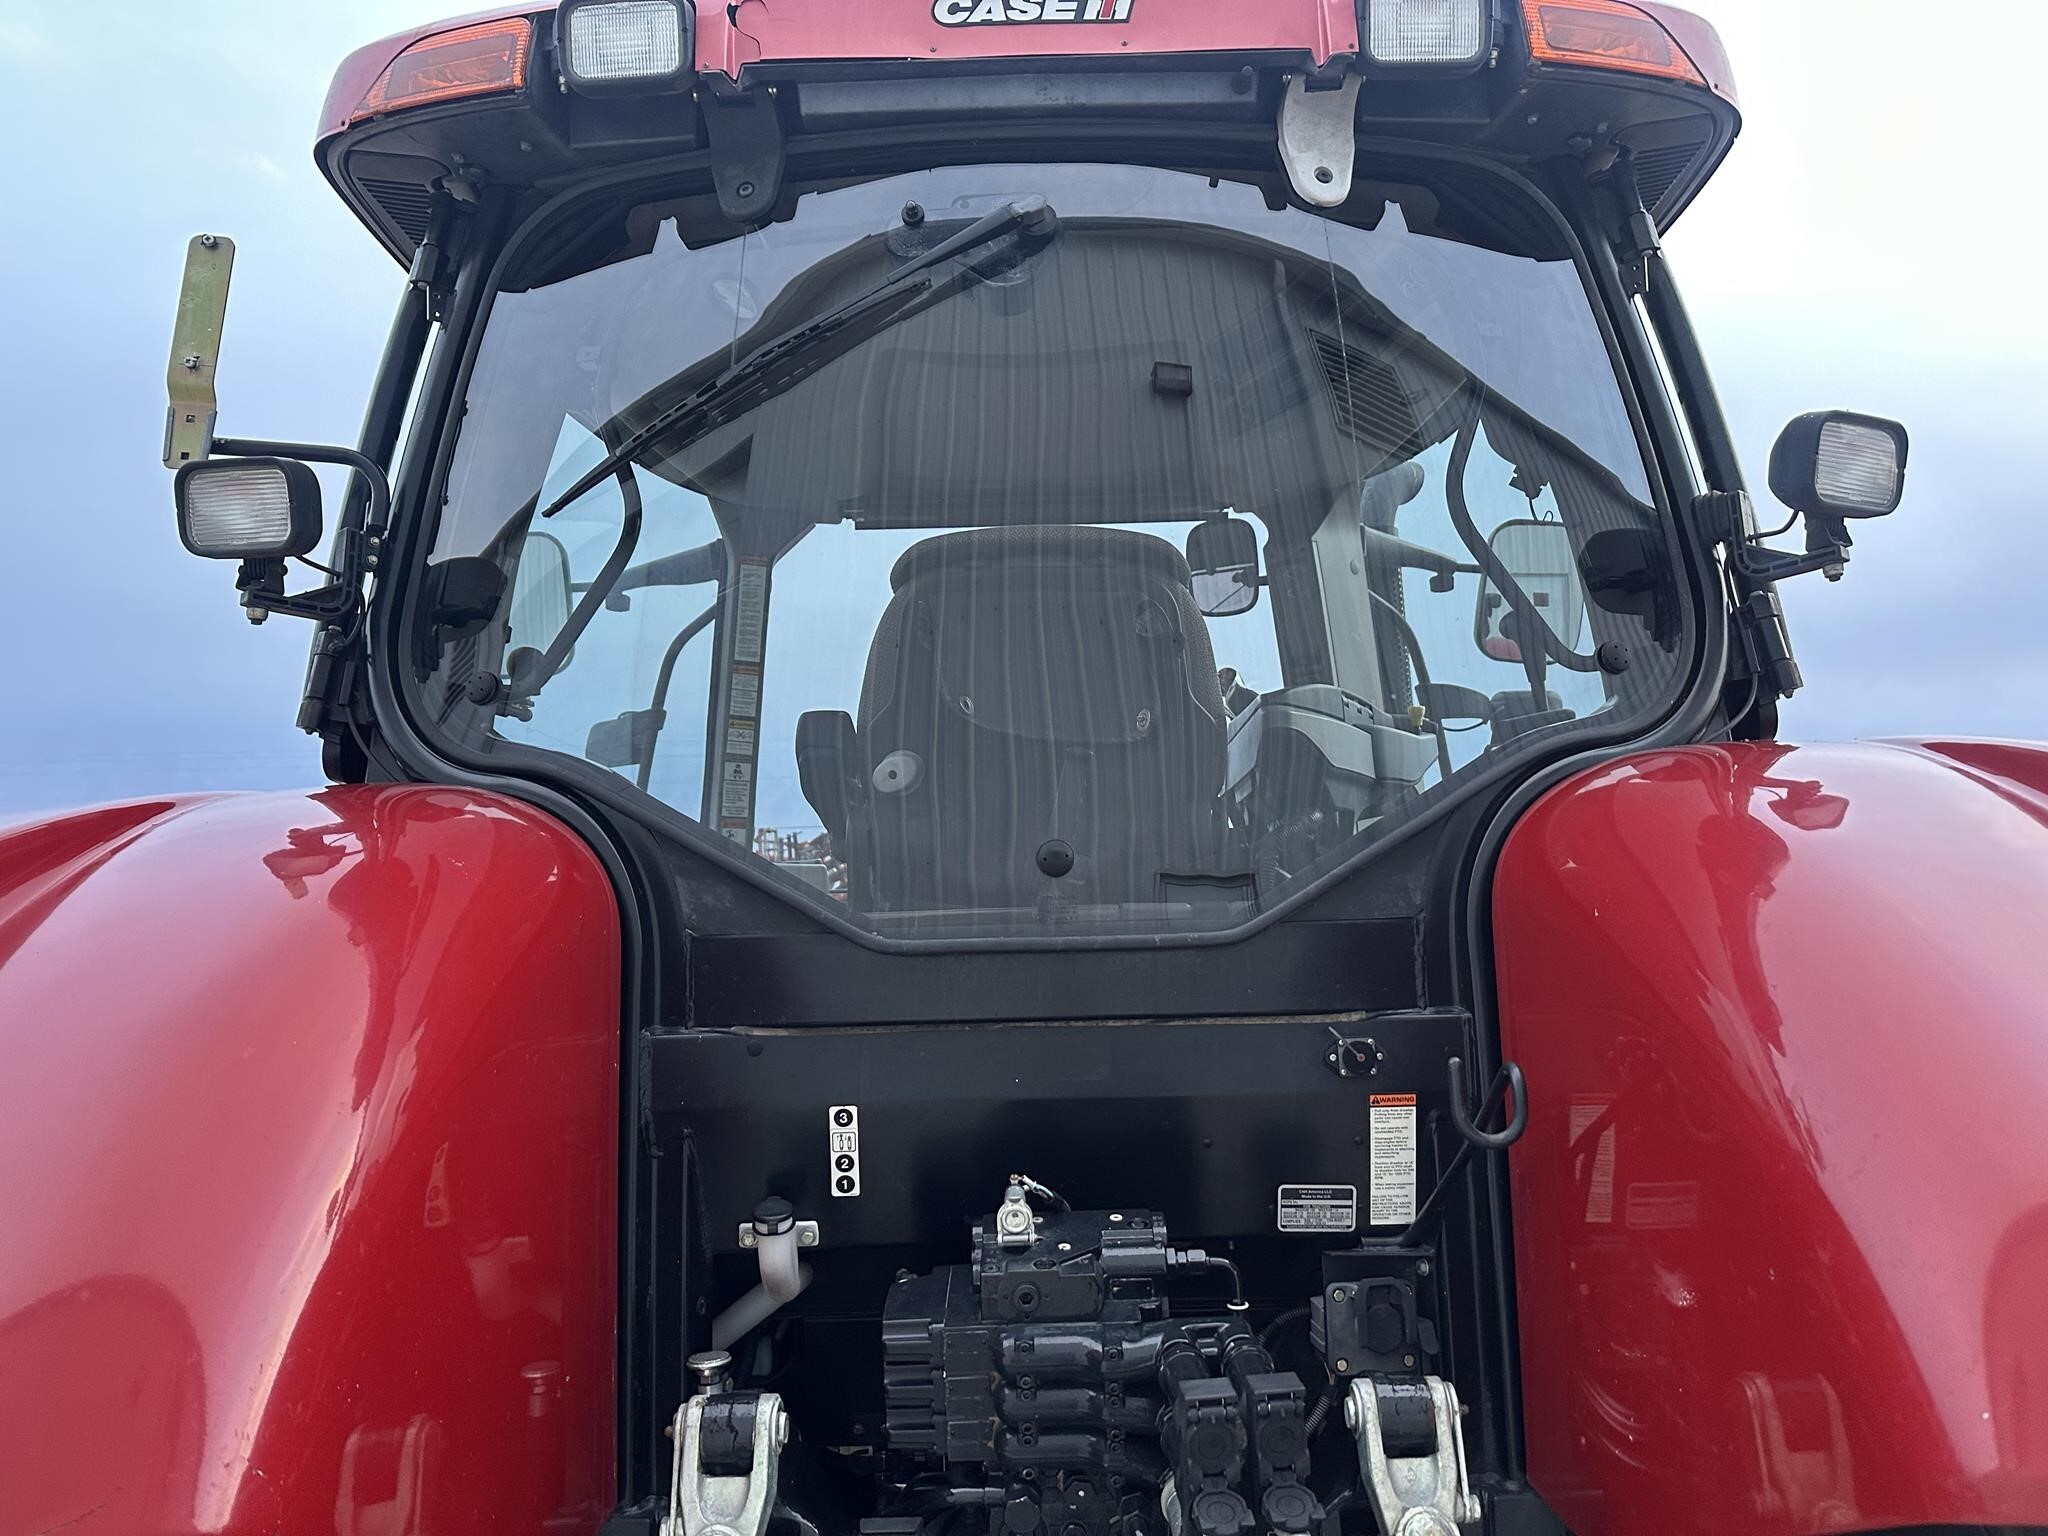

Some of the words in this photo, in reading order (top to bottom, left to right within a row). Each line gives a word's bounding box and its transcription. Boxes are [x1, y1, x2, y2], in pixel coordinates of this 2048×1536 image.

[934, 0, 1078, 24] CASE
[840, 1112, 848, 1123] 3
[840, 1158, 849, 1168] 2
[842, 1179, 847, 1189] 1
